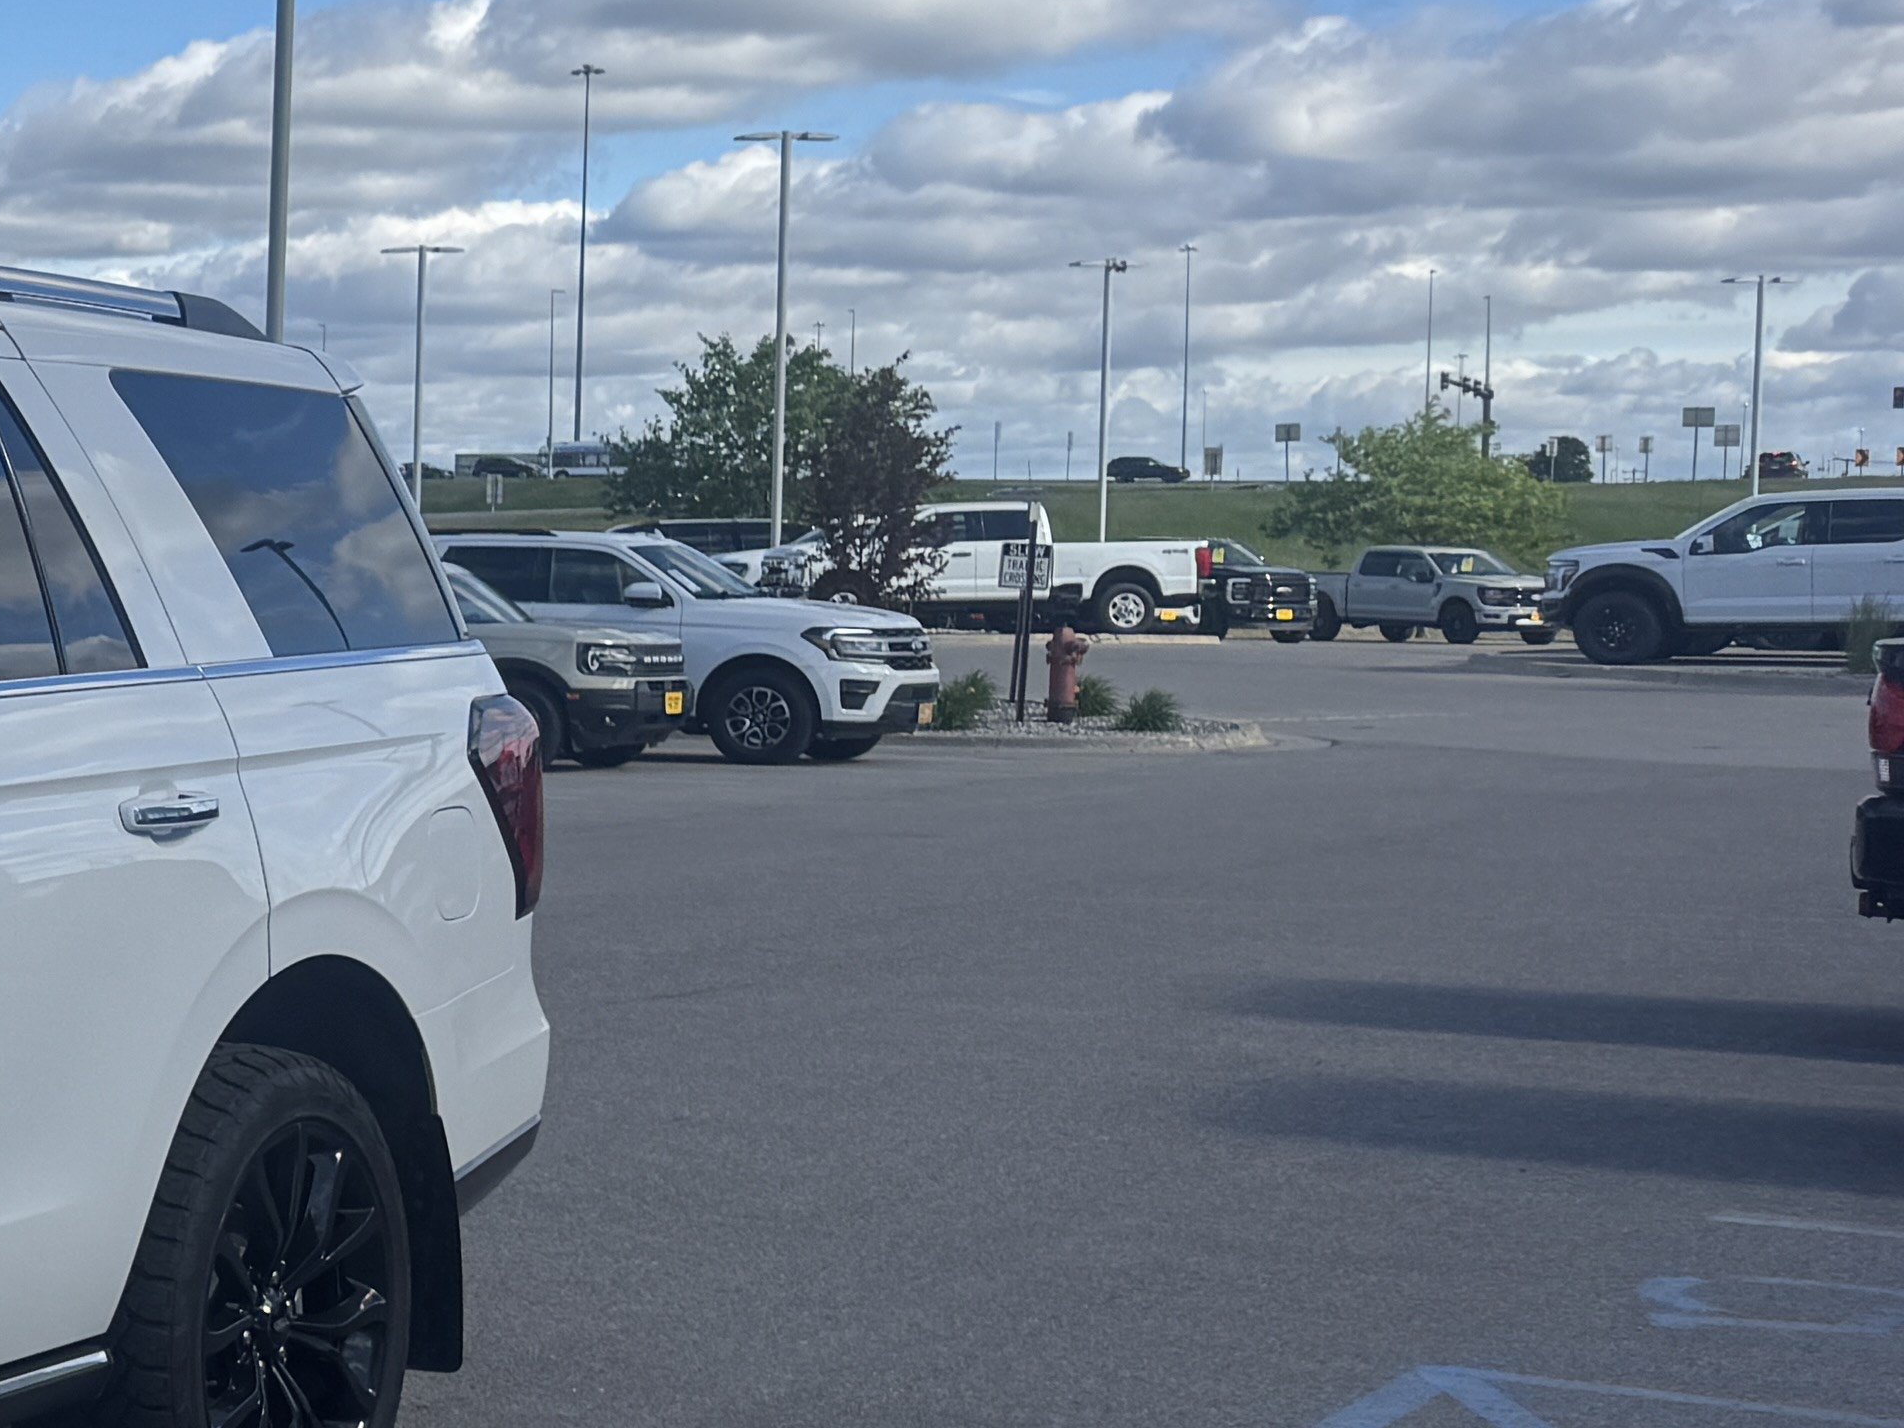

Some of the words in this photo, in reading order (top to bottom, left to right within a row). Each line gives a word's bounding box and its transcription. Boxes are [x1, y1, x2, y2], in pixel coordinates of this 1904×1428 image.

[1009, 543, 1047, 558] SLW
[1008, 559, 1046, 572] TRAIC
[1003, 572, 1046, 585] CROSNG
